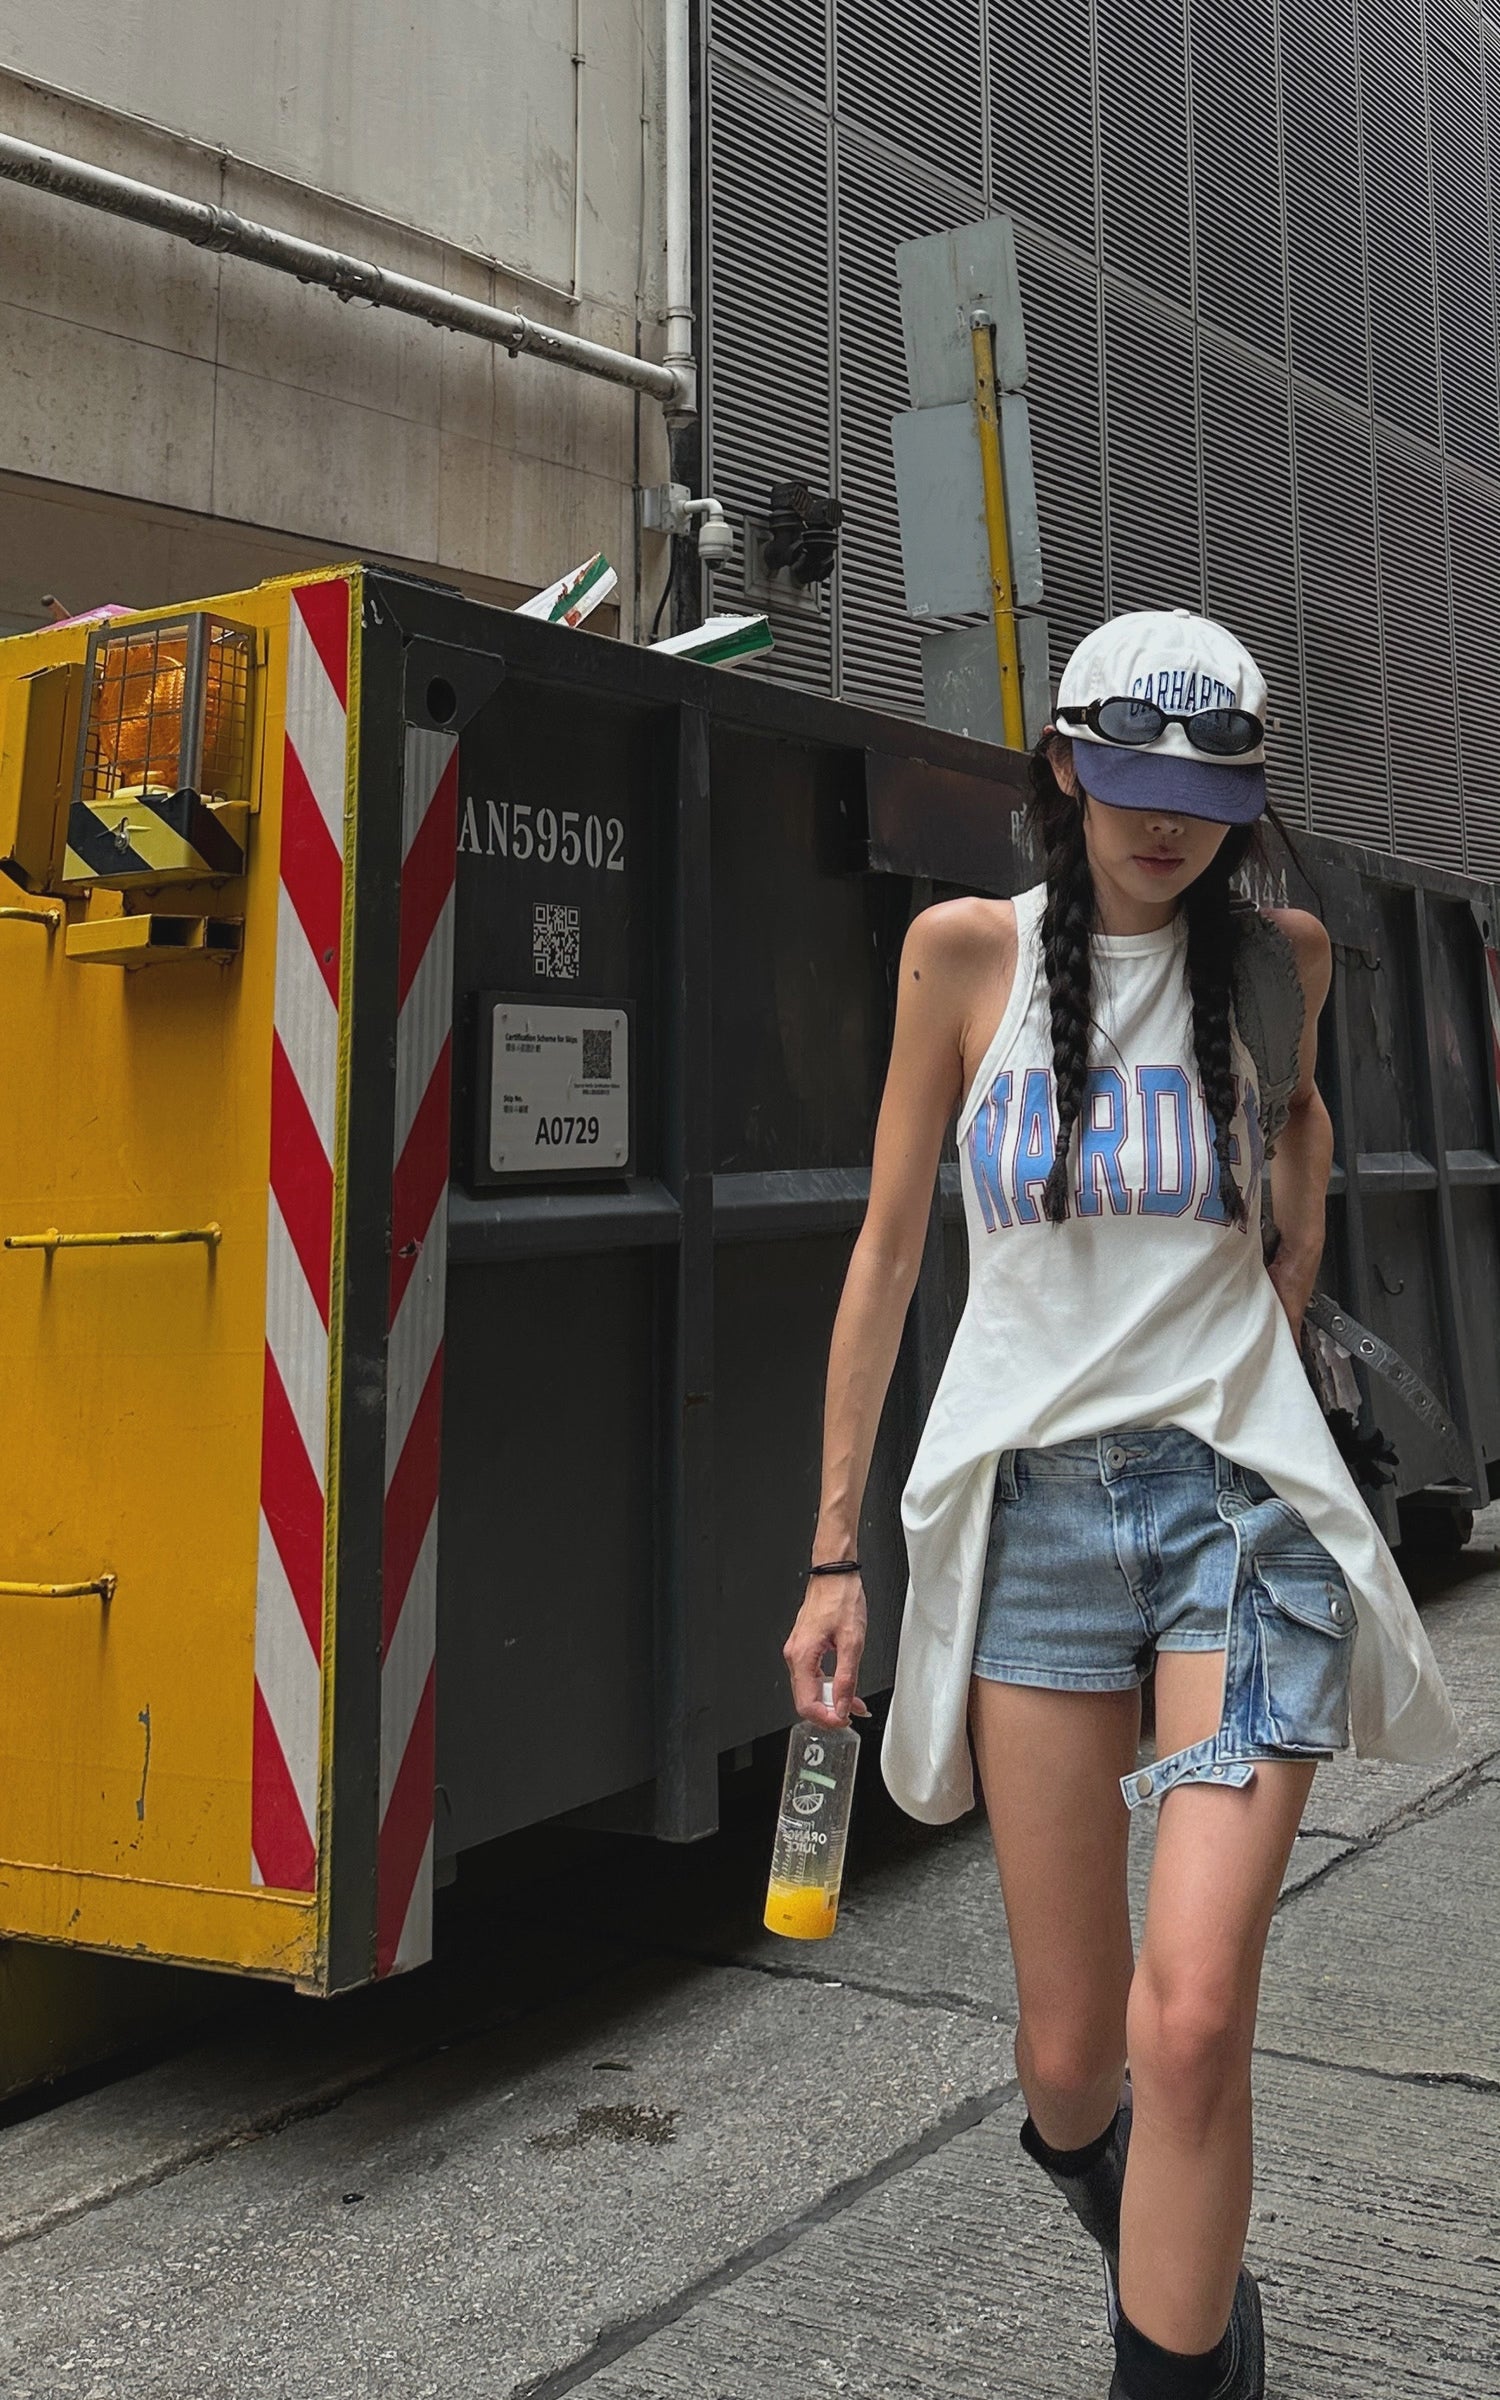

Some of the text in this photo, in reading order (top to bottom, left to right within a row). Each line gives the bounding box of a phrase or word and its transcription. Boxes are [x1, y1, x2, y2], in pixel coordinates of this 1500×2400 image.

[1131, 671, 1236, 726] CARHARTT
[457, 796, 624, 871] AN59502
[535, 1116, 599, 1145] A0729
